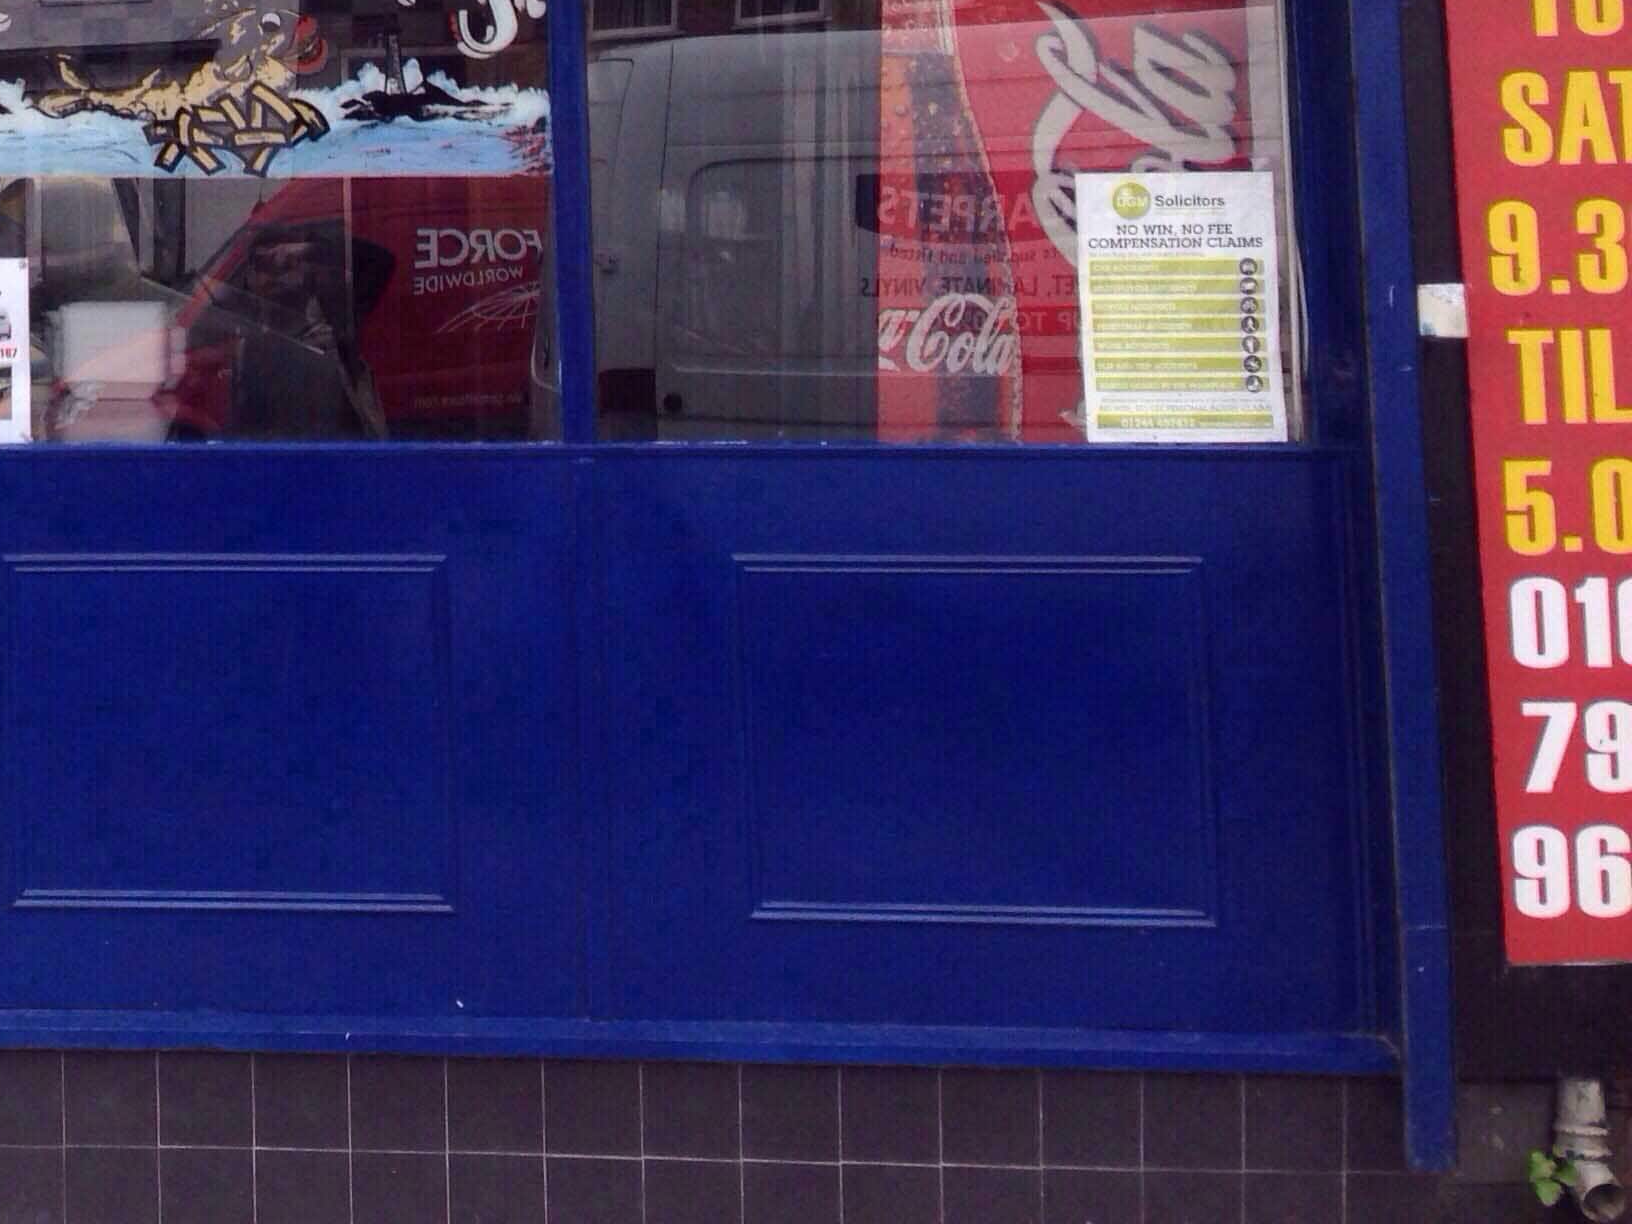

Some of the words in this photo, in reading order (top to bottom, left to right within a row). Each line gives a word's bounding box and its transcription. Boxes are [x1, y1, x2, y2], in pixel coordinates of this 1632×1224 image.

[1154, 193, 1226, 208] Solicitors
[1116, 224, 1139, 236] NO
[1143, 223, 1178, 237] WIN,
[1182, 223, 1205, 236] NO
[1207, 223, 1234, 236] FEE
[1088, 237, 1203, 250] COMPENSATION
[1206, 236, 1264, 249] CLAIMS
